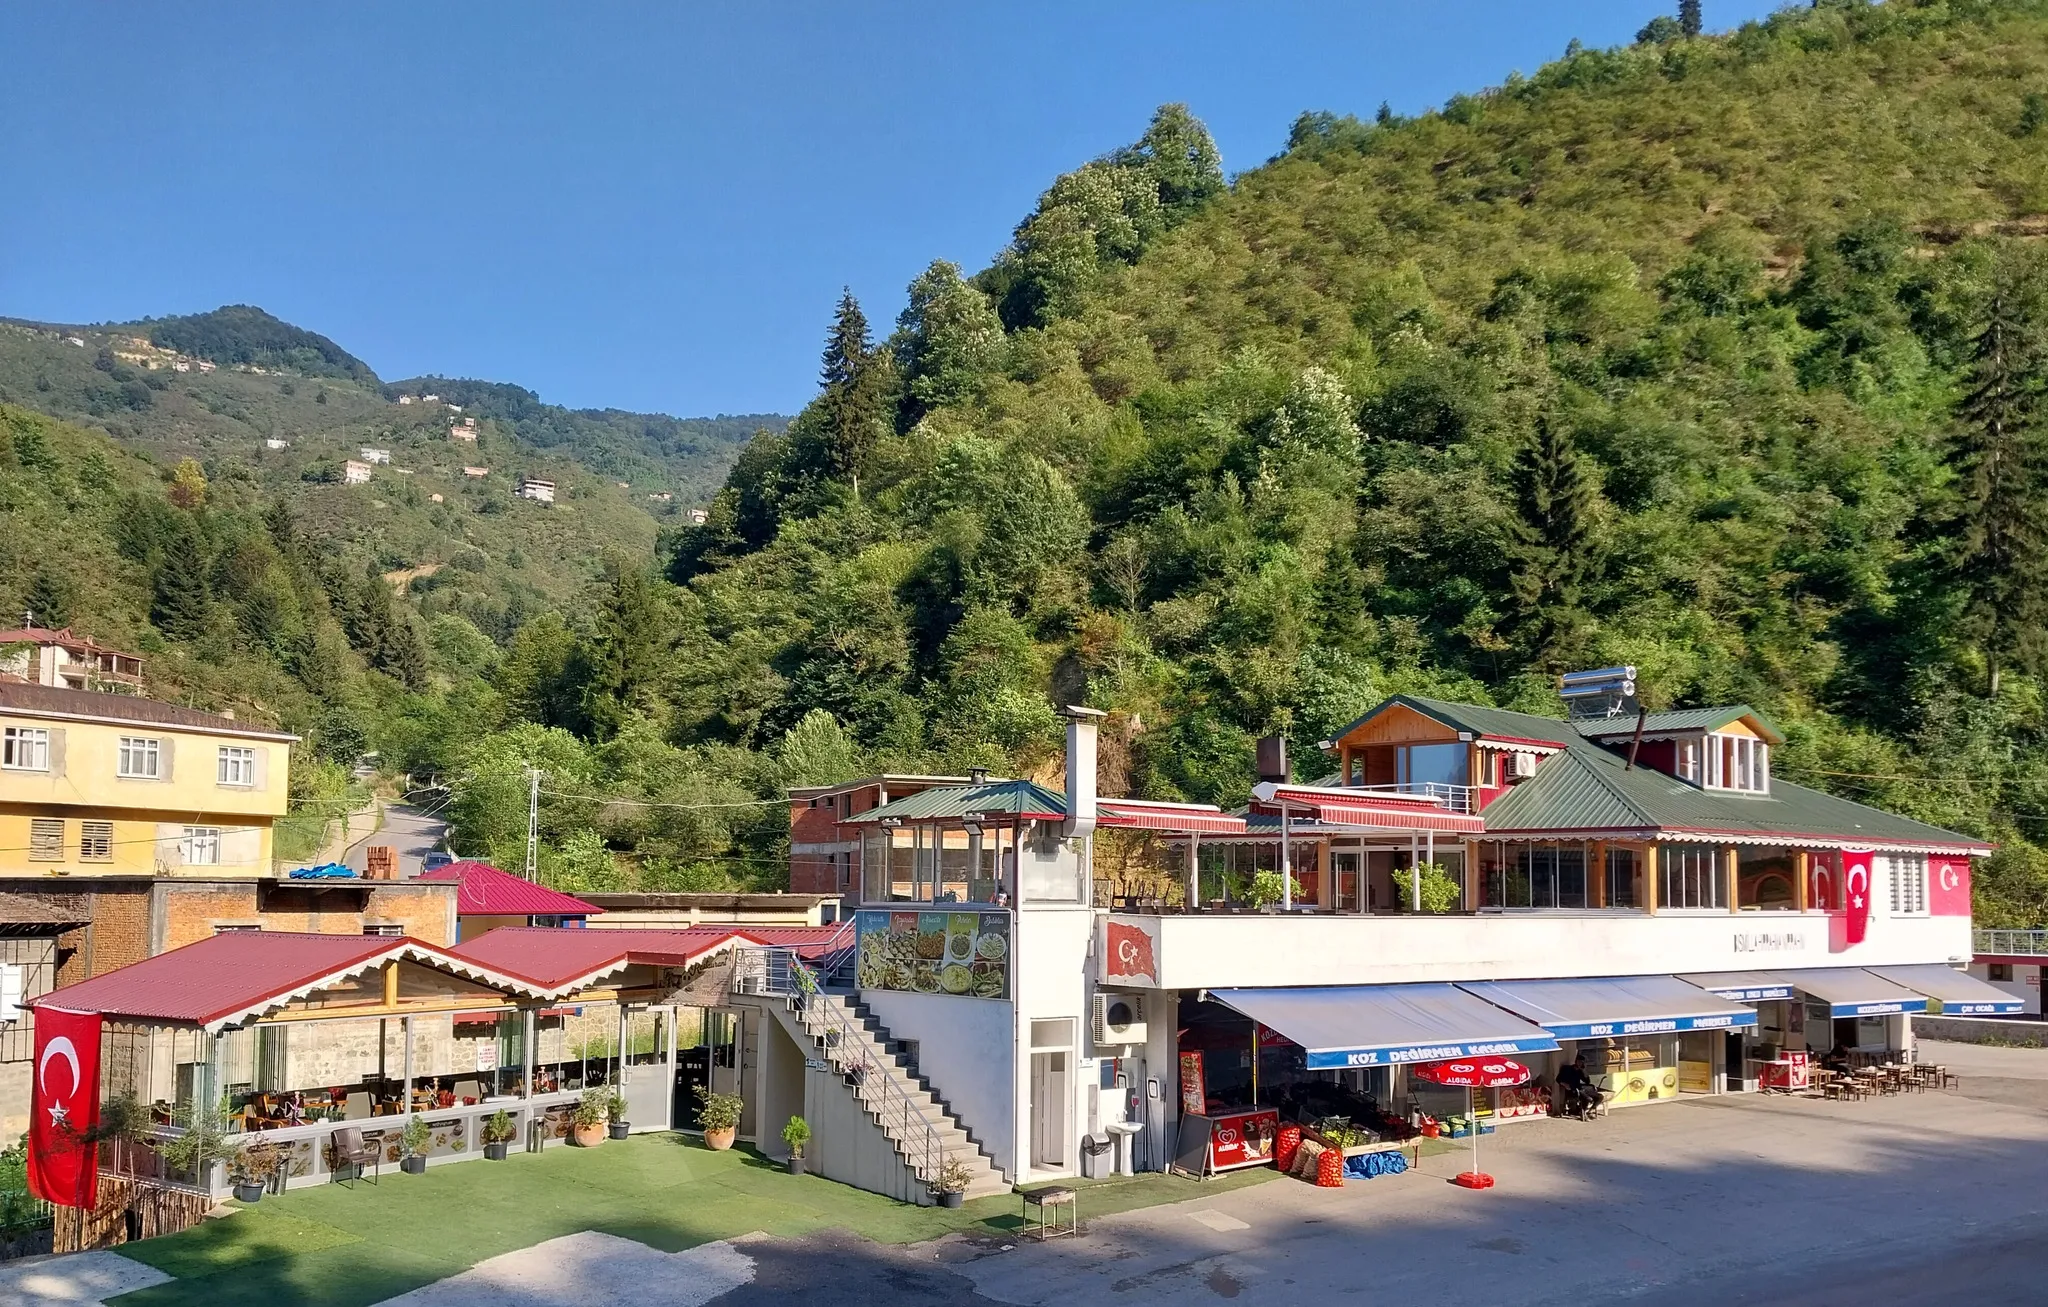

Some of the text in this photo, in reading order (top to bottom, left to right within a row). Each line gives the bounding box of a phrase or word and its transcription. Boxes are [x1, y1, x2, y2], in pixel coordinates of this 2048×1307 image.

[1590, 1016, 1734, 1036] KOZ DEĞİRMEN MARKET
[1347, 1042, 1520, 1066] KOZ DEĞİRMEN KASABI
[1446, 1077, 1472, 1085] ALGIDA
[1490, 1077, 1514, 1086] ALGIDA
